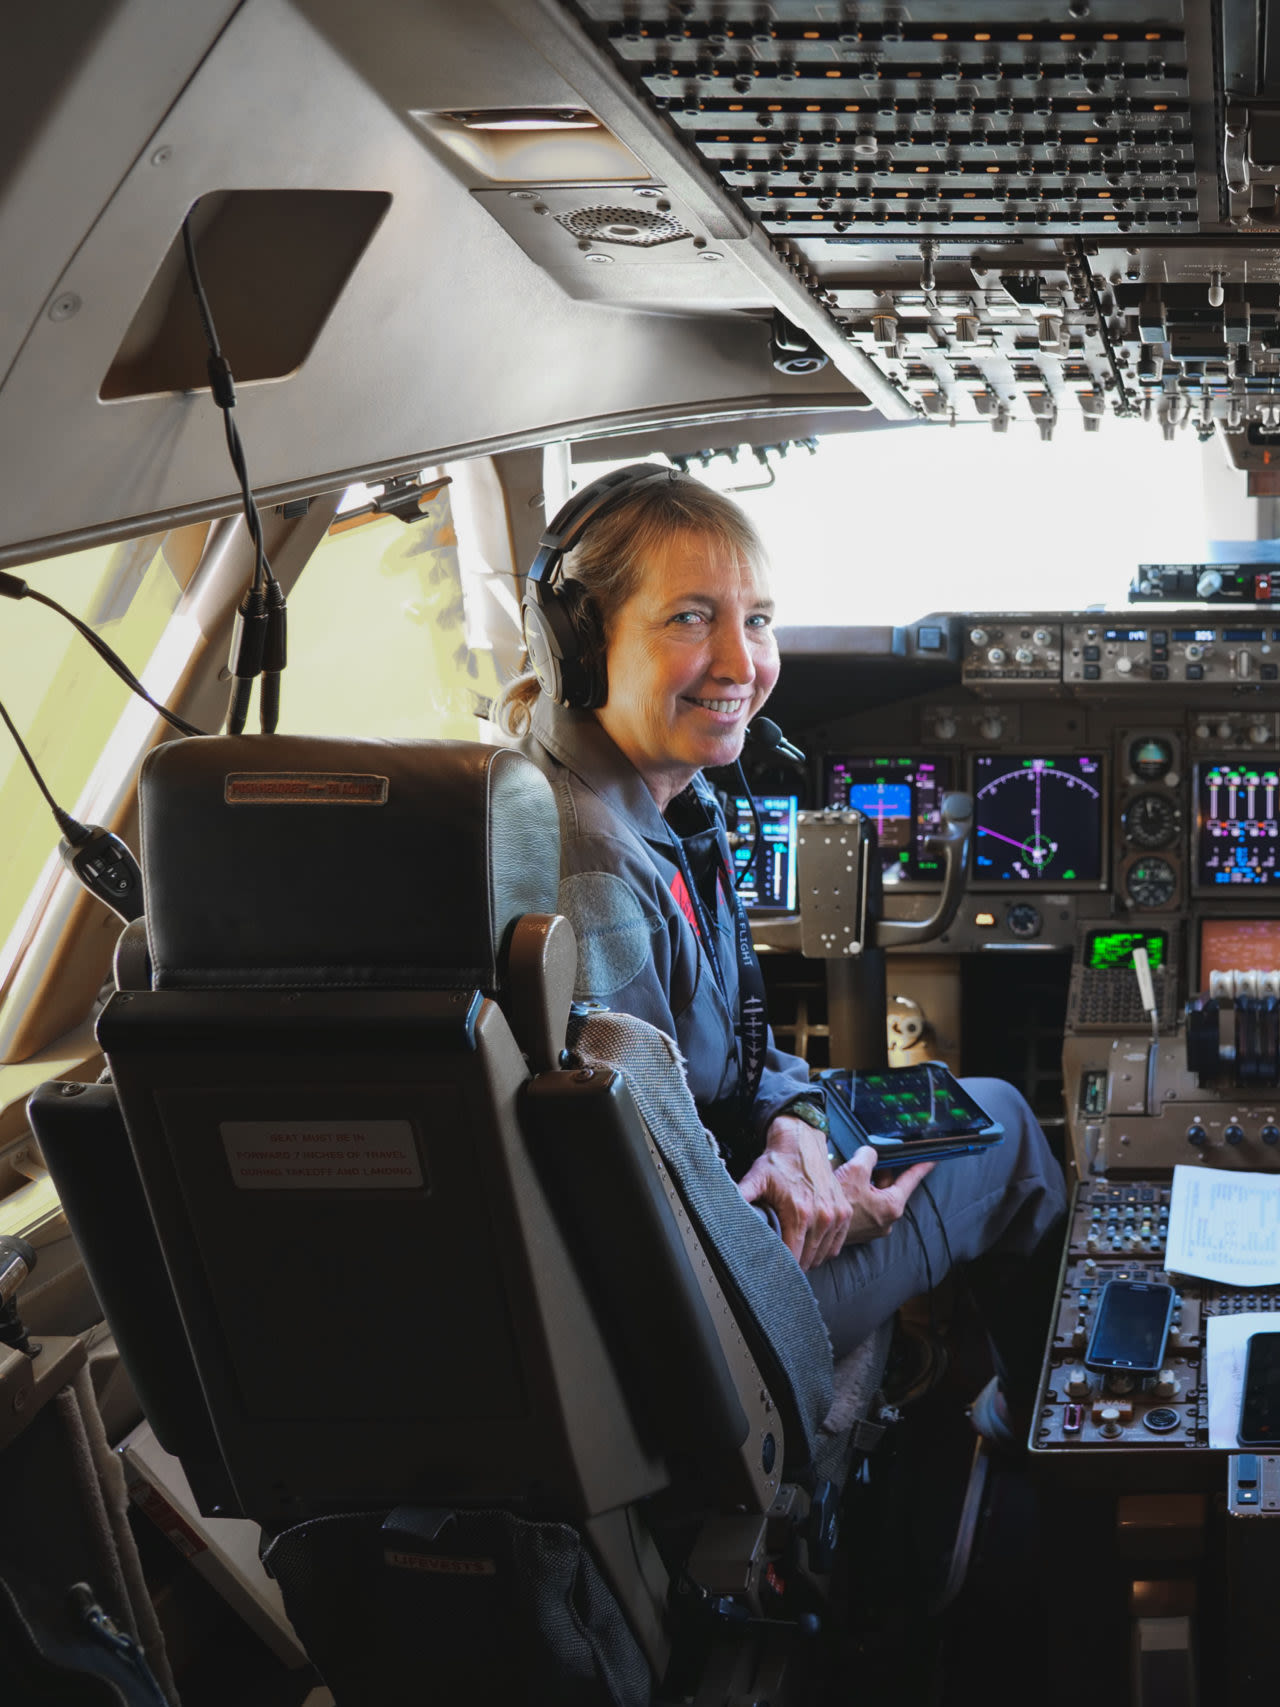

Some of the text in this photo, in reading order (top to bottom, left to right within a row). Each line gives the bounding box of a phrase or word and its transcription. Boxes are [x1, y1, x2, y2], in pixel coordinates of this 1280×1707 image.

[739, 922, 754, 969] FLIGHT
[270, 1133, 365, 1143] SEAT MUST BE IN
[236, 1151, 406, 1160] FORWARD 7 INCHES OF TRAVEL
[240, 1167, 412, 1177] DURING TAKEOFF AND LANDING
